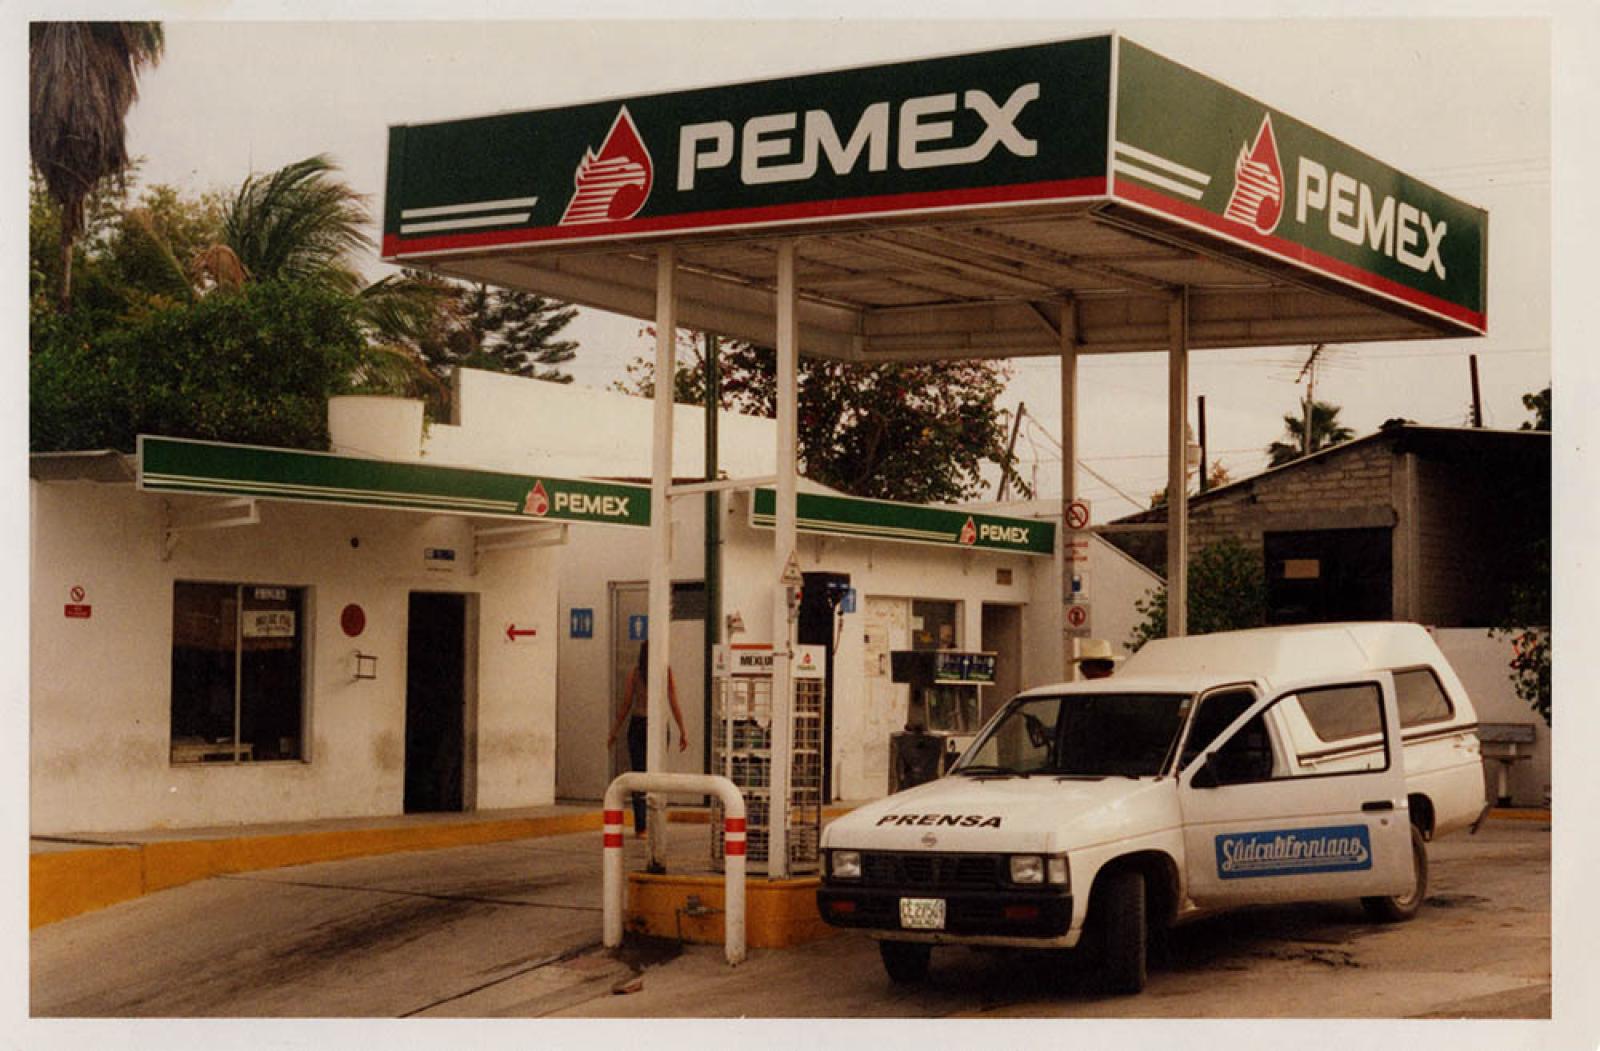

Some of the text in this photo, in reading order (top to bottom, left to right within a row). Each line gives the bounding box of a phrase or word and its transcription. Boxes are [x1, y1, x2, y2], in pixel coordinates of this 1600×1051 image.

[677, 82, 1040, 191] PEMEX
[1296, 155, 1447, 280] PEMEX
[554, 491, 629, 517] PEMEX
[980, 524, 1029, 544] PEMEX
[876, 813, 1002, 828] PRENSA
